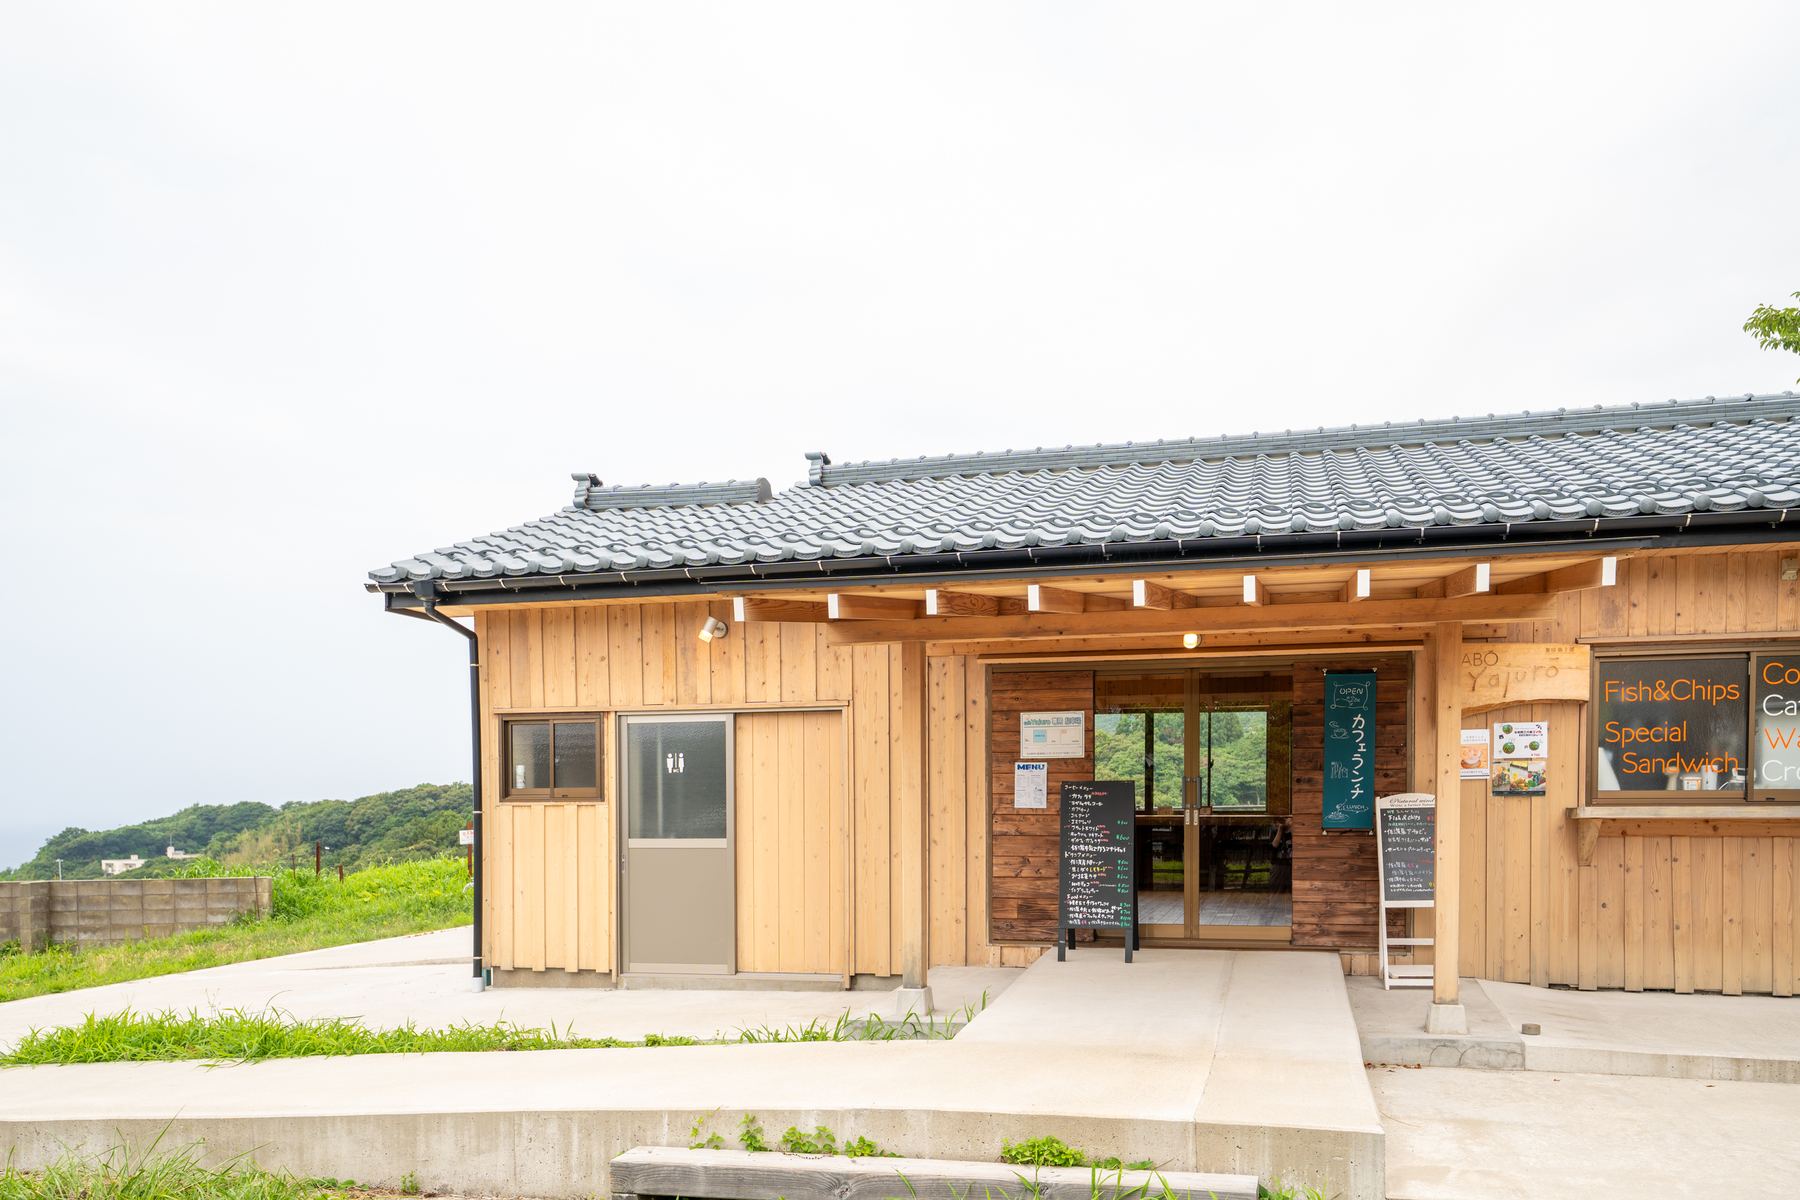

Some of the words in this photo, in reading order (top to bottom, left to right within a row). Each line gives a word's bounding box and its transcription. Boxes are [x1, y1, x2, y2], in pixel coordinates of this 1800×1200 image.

[1339, 687, 1364, 695] OPEN
[1604, 679, 1741, 706] Fish&Chips
[1762, 694, 1800, 716] Ca
[1604, 720, 1687, 748] Special
[1350, 713, 1367, 800] カフェランチ
[1622, 751, 1739, 774] Sandwich
[1762, 760, 1800, 781] Cr
